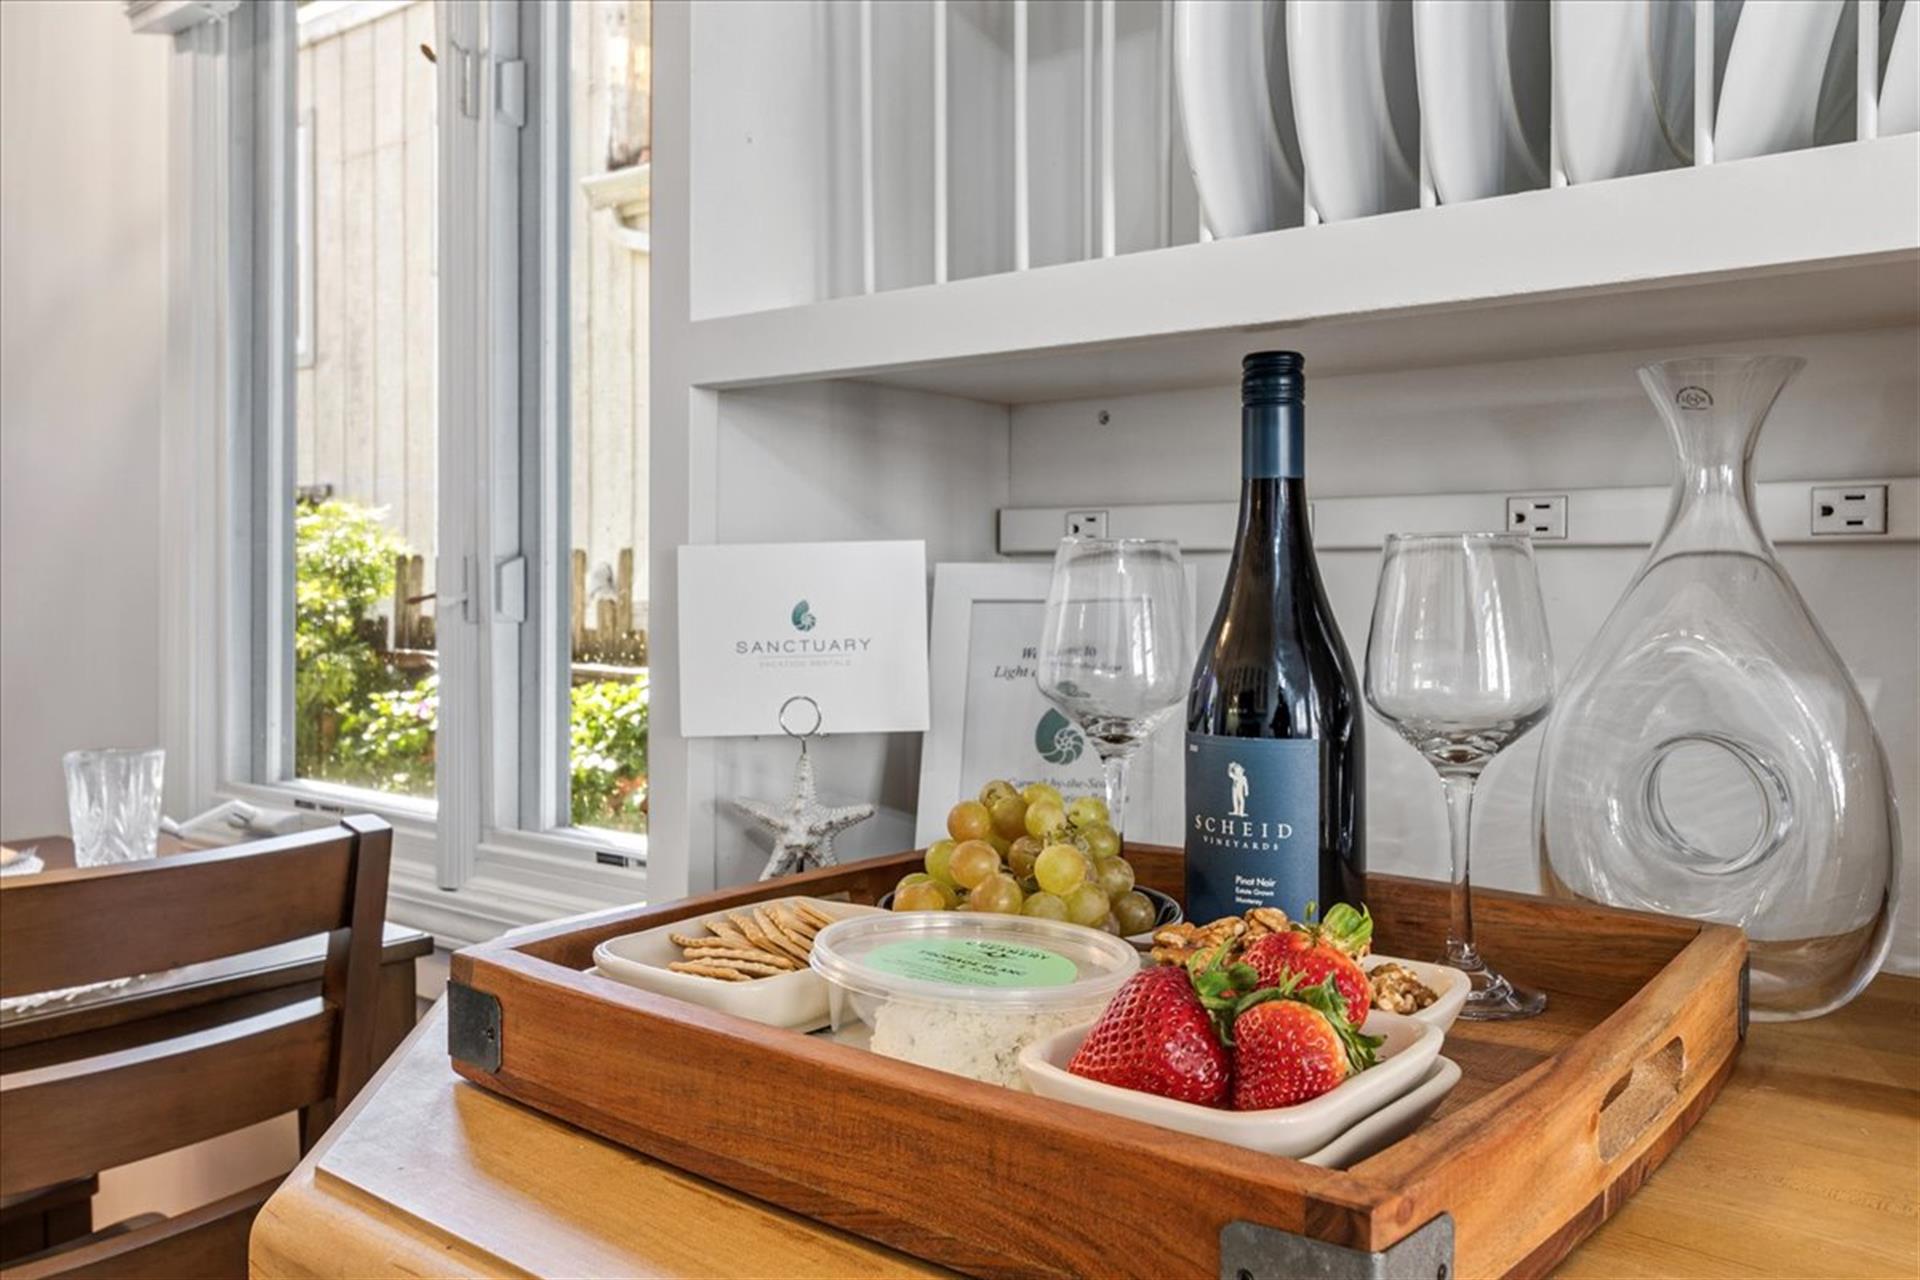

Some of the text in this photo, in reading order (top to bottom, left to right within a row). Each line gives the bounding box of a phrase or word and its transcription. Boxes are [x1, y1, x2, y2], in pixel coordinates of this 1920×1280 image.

[735, 638, 872, 655] SANCTUARY
[994, 665, 1029, 681] Light
[1194, 814, 1293, 840] SCHEID
[1202, 835, 1279, 852] VINEYARDS
[1234, 875, 1277, 888] Pinot Noir
